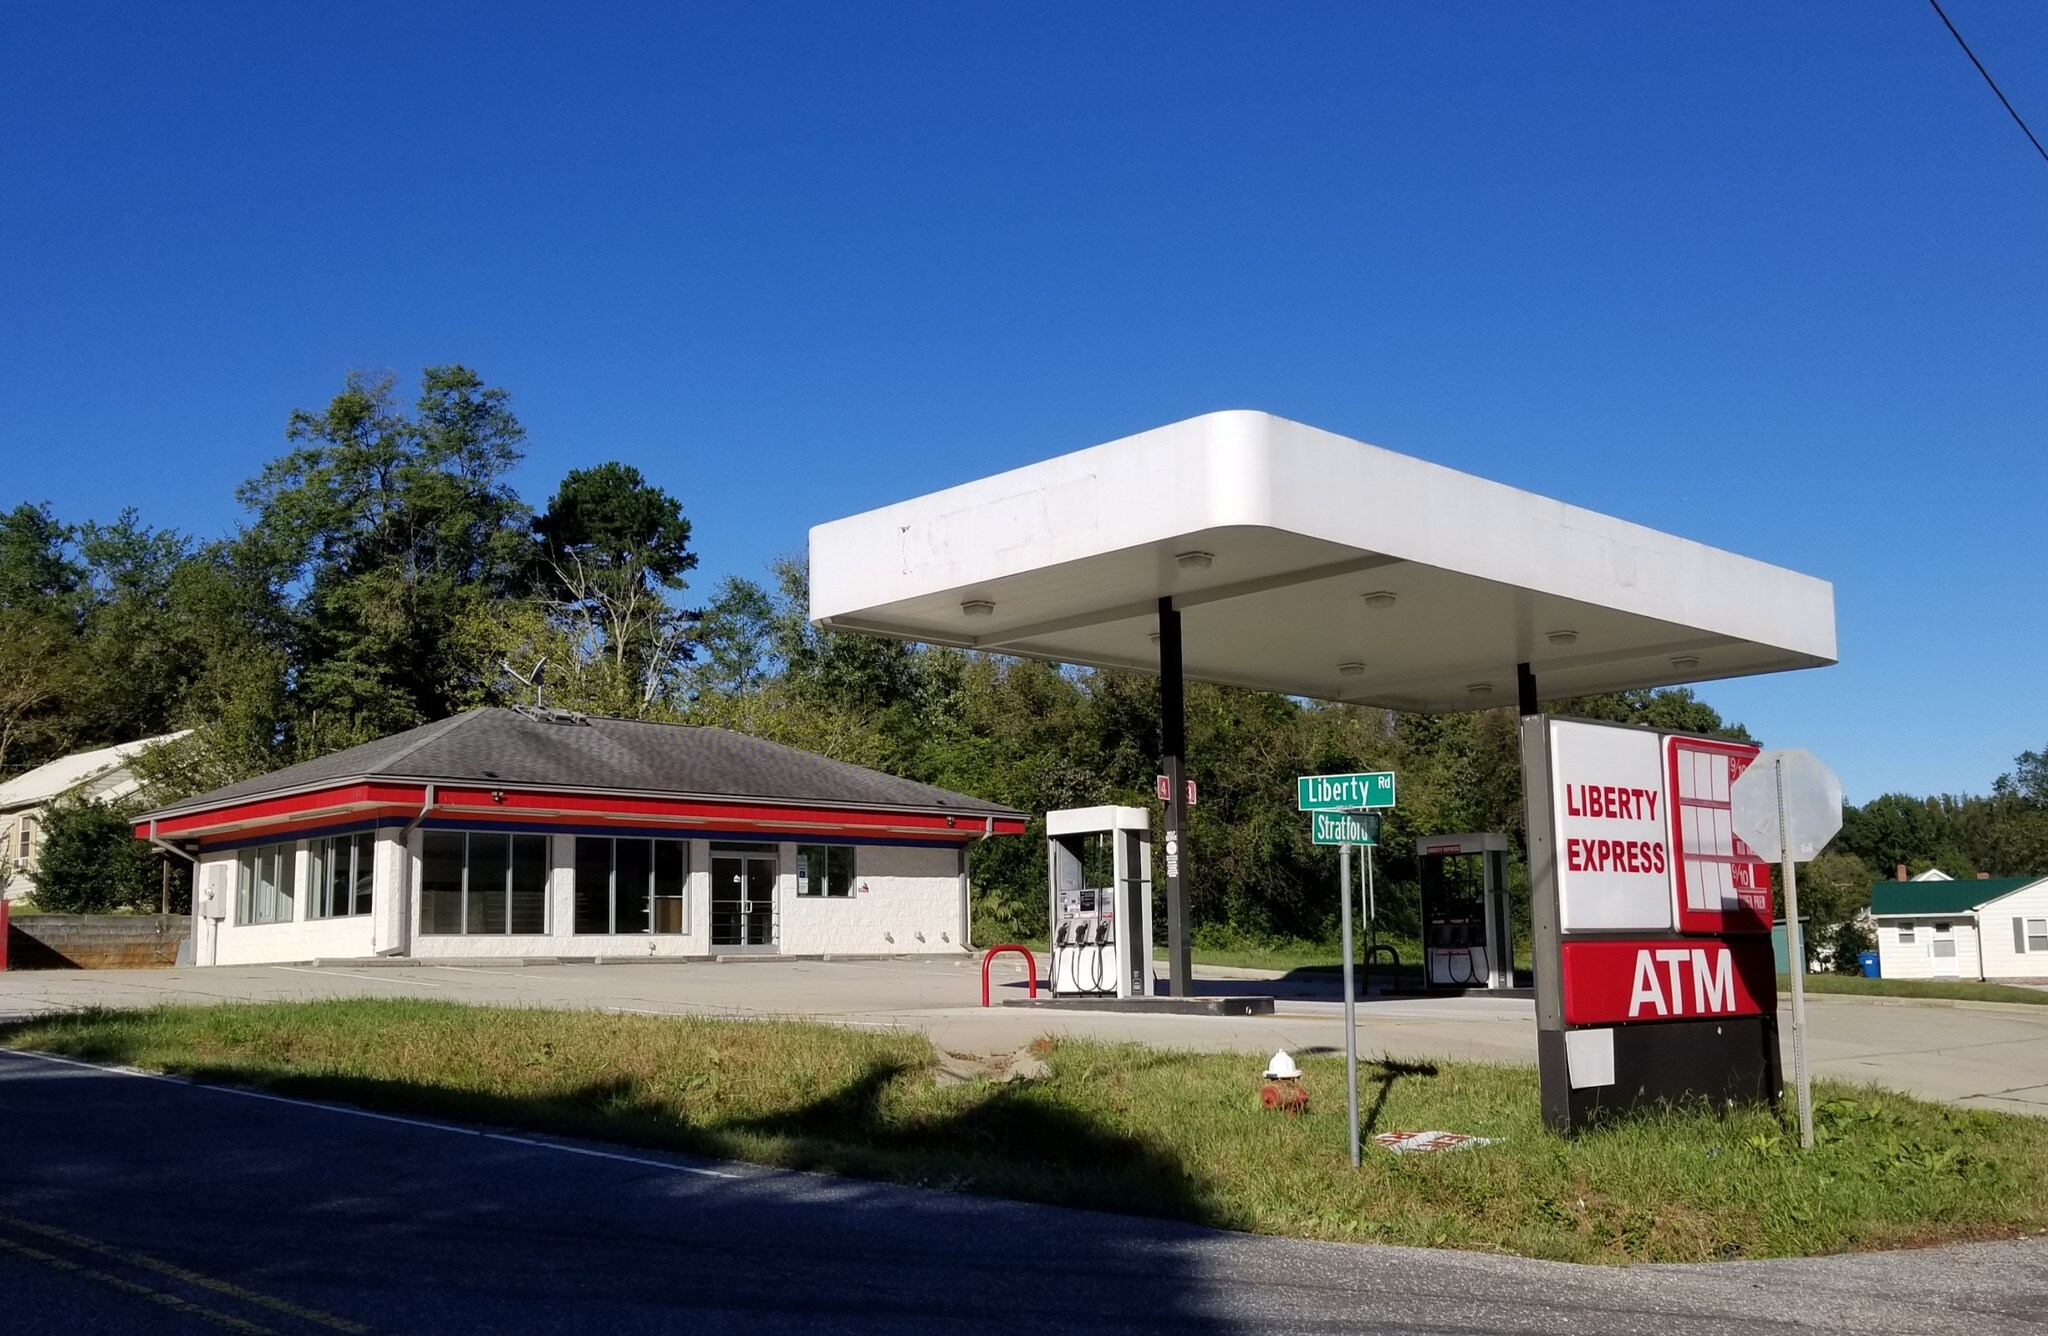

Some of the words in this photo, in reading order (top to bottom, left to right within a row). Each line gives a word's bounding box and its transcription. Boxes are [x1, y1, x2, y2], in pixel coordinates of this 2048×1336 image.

[1160, 781, 1167, 795] 4
[1308, 777, 1369, 806] Liberty
[1378, 776, 1391, 789] Rd
[1566, 783, 1658, 821] LIBERTY
[1566, 838, 1665, 874] EXPRESS
[1628, 948, 1736, 1017] ATM
